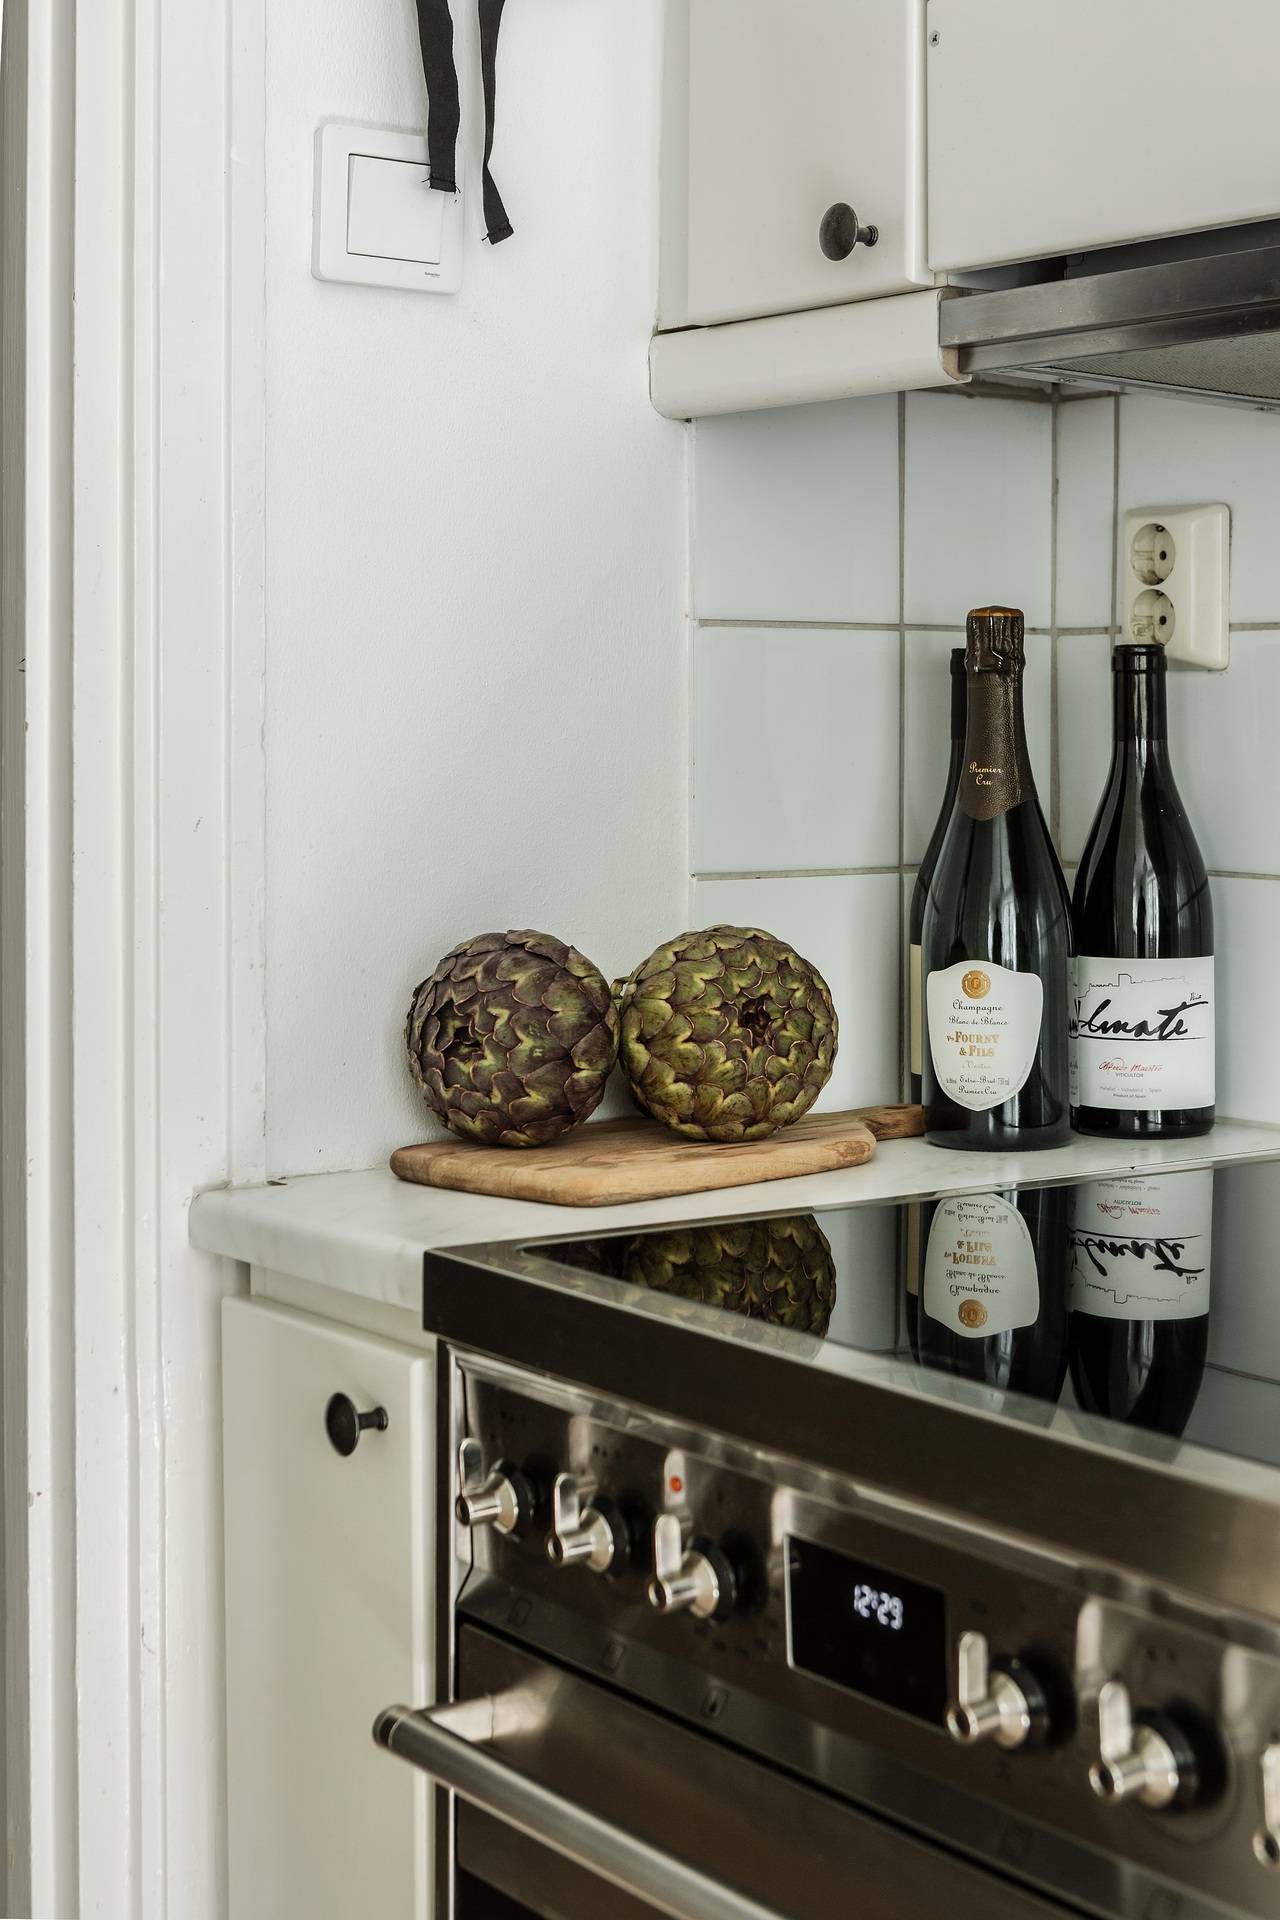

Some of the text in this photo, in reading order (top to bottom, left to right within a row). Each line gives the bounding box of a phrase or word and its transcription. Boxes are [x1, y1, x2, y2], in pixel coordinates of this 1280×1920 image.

[969, 761, 1003, 773] Premier
[976, 774, 992, 786] Cru
[952, 999, 1003, 1015] Champagne
[948, 1015, 969, 1025] Blanc
[959, 1047, 967, 1056] &
[958, 1086, 998, 1096] Premier Cru
[853, 1583, 904, 1631] 12:29
